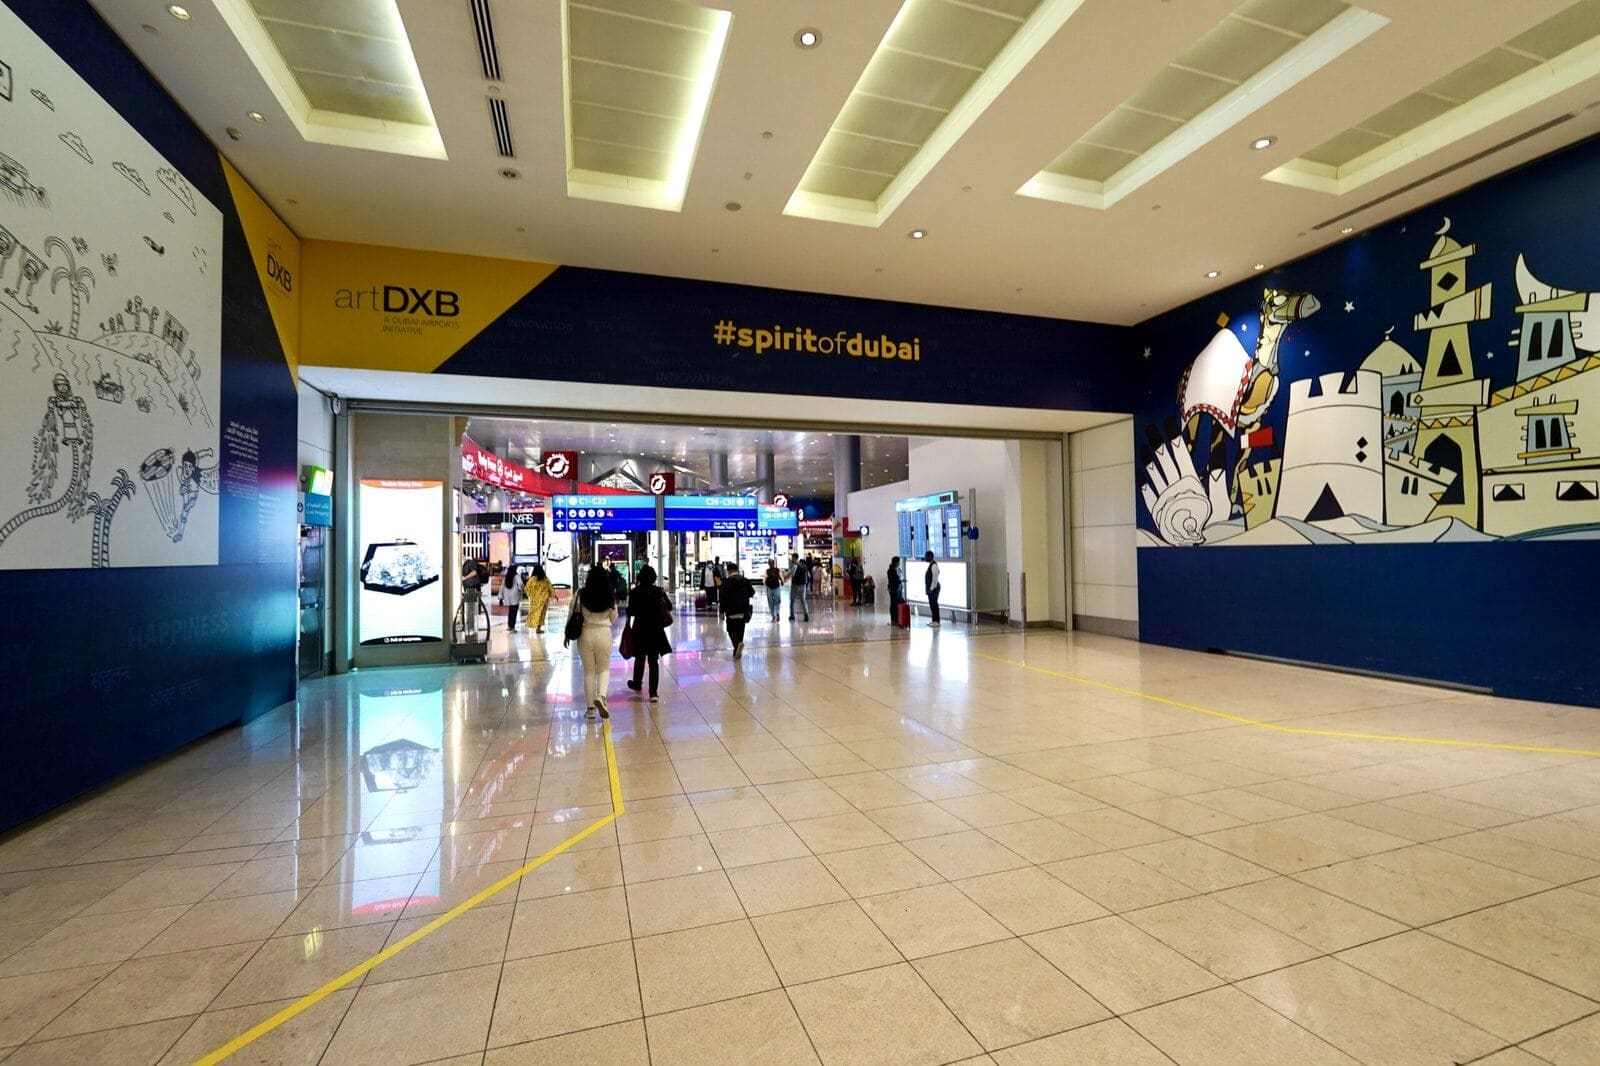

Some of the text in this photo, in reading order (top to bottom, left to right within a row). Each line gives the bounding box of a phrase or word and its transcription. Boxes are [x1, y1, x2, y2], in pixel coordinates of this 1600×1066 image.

[267, 253, 292, 292] DXB
[334, 285, 460, 317] artDXB
[383, 325, 423, 336] INITIATIVE
[393, 316, 418, 326] DUBAI
[421, 319, 460, 329] AIRPORTS
[713, 320, 921, 361] #spiritofdubai
[512, 513, 534, 524] NARS
